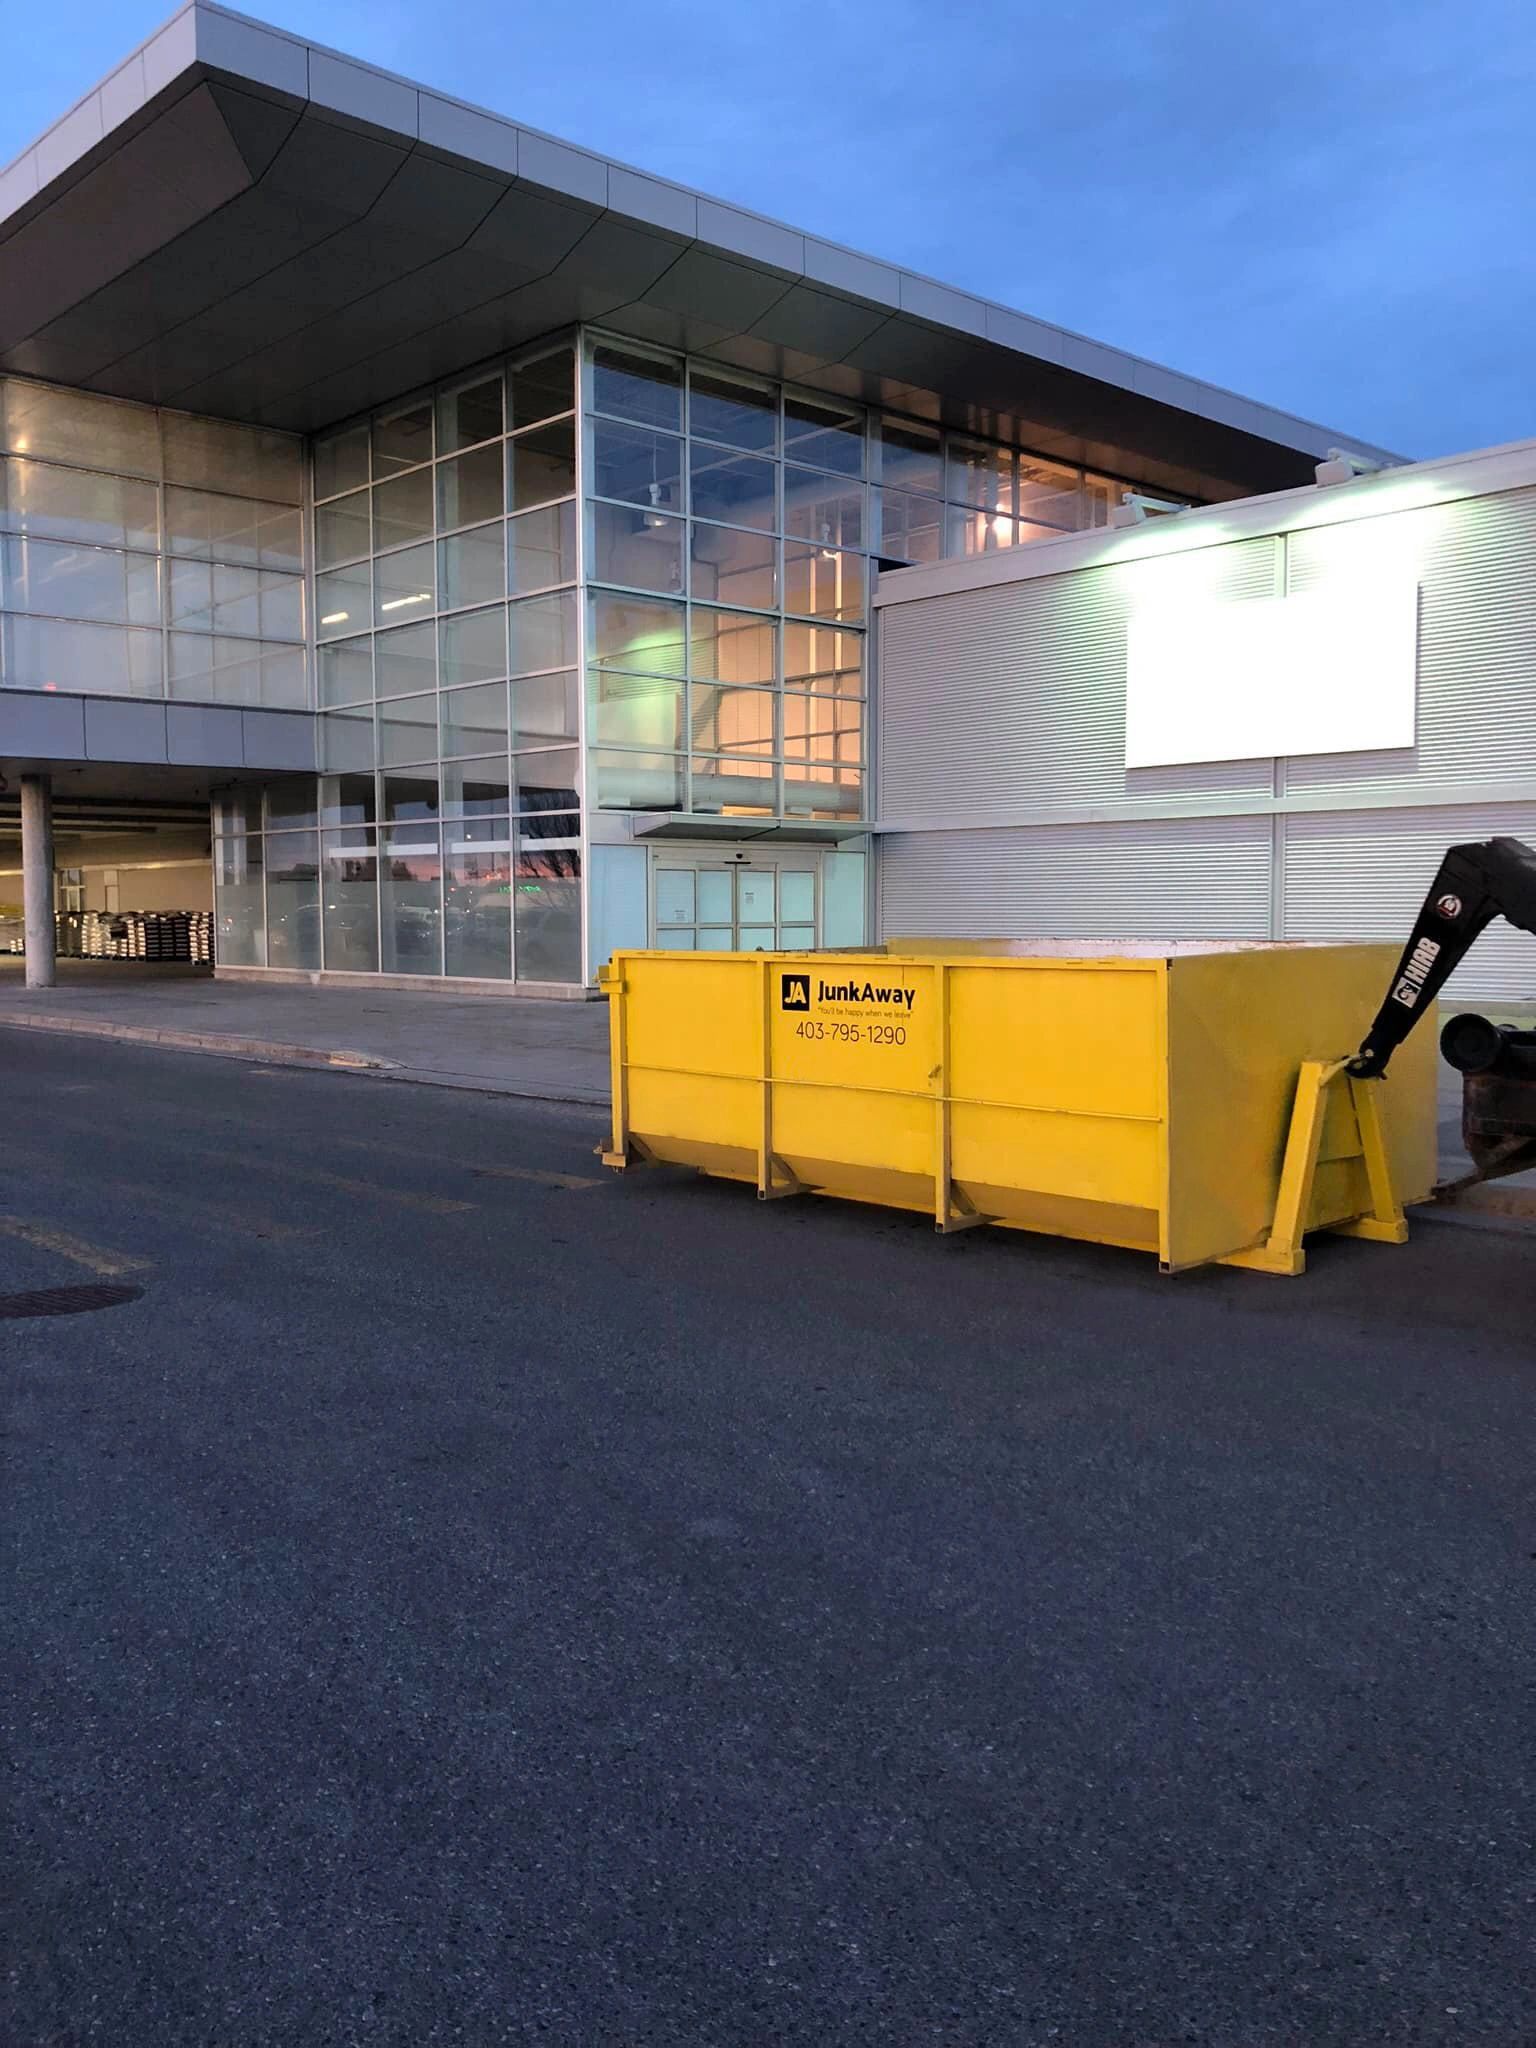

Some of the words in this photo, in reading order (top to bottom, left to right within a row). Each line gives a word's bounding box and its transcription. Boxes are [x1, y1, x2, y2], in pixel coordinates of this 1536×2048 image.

[1404, 937, 1440, 985] HIAB
[818, 980, 916, 1010] JunkAway
[845, 1008, 864, 1018] happy
[865, 1009, 882, 1017] when
[796, 1021, 906, 1045] 403-795-1290
